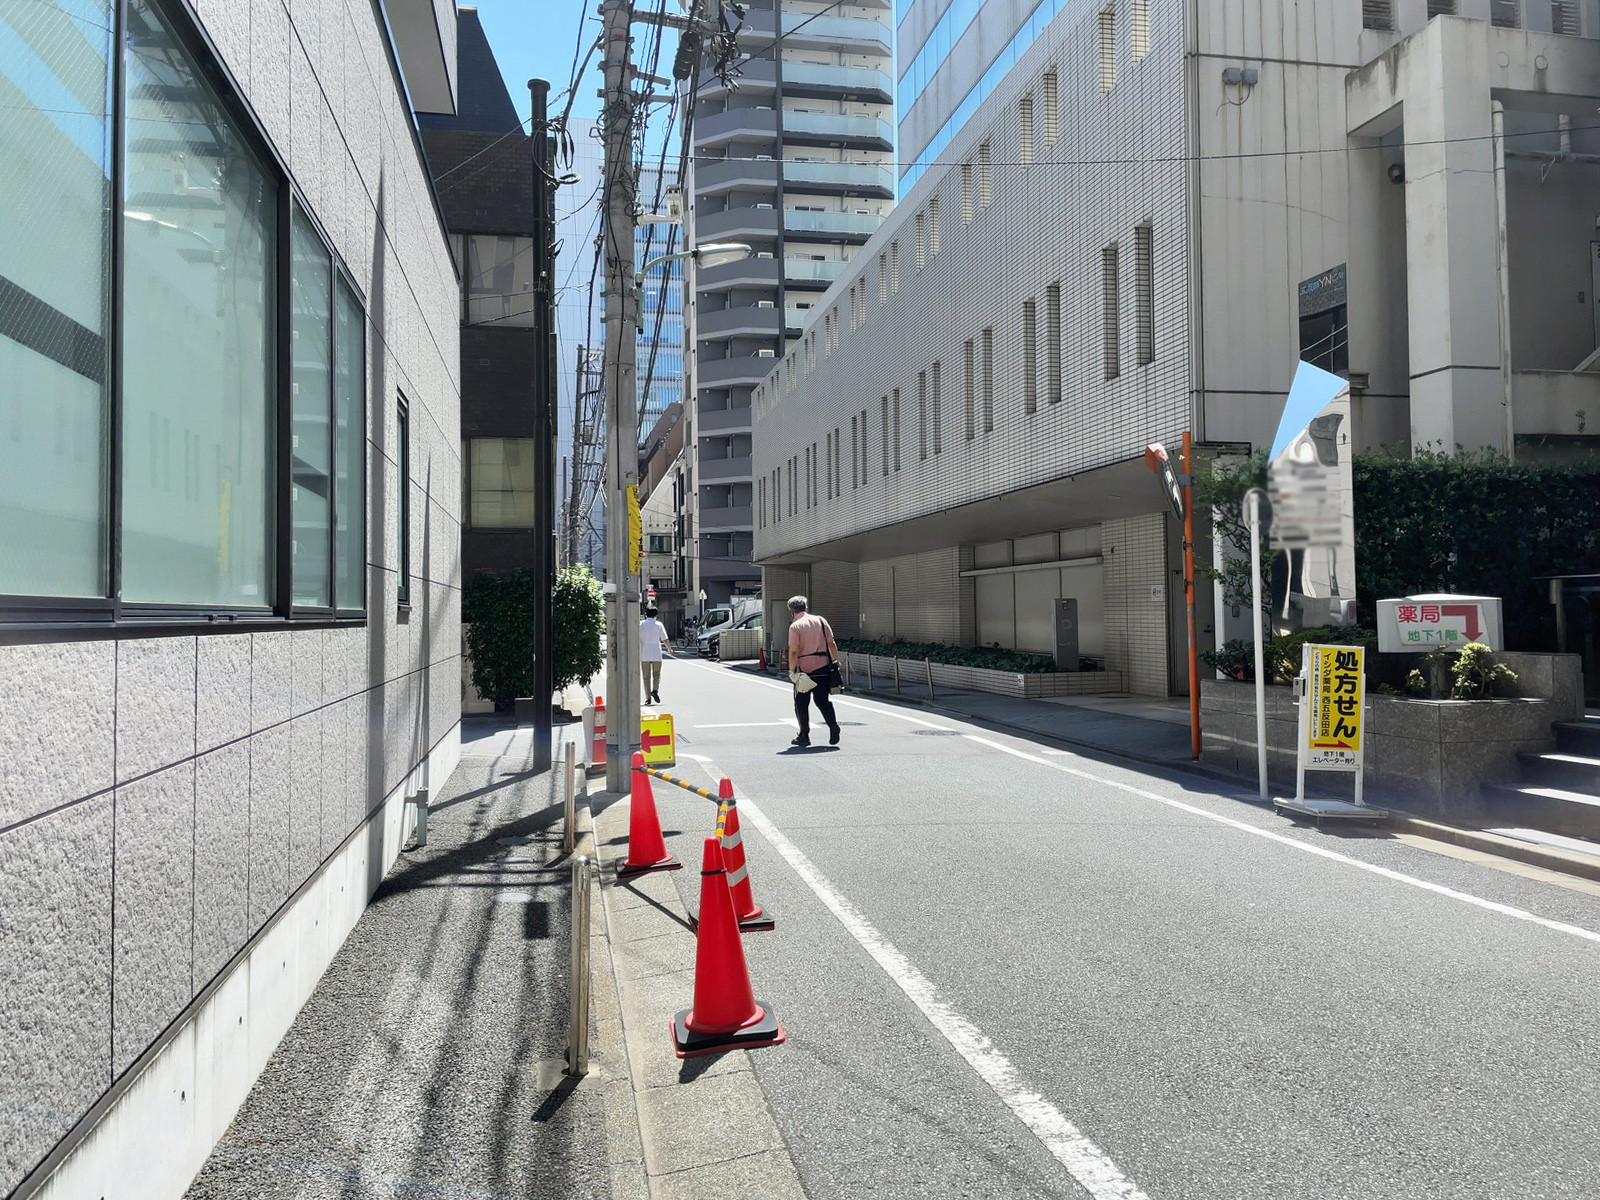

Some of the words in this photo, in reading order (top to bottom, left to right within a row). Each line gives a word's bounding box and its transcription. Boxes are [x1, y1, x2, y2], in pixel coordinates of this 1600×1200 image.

[1398, 605, 1440, 623] 薬局
[1407, 629, 1458, 642] 地下1階
[1322, 652, 1332, 693] イシダ薬局
[1333, 650, 1358, 738] 処方せん
[1320, 696, 1331, 737] 西五反田店
[1312, 756, 1356, 765] エレベーター有り
[1323, 750, 1345, 758] 地下1階
